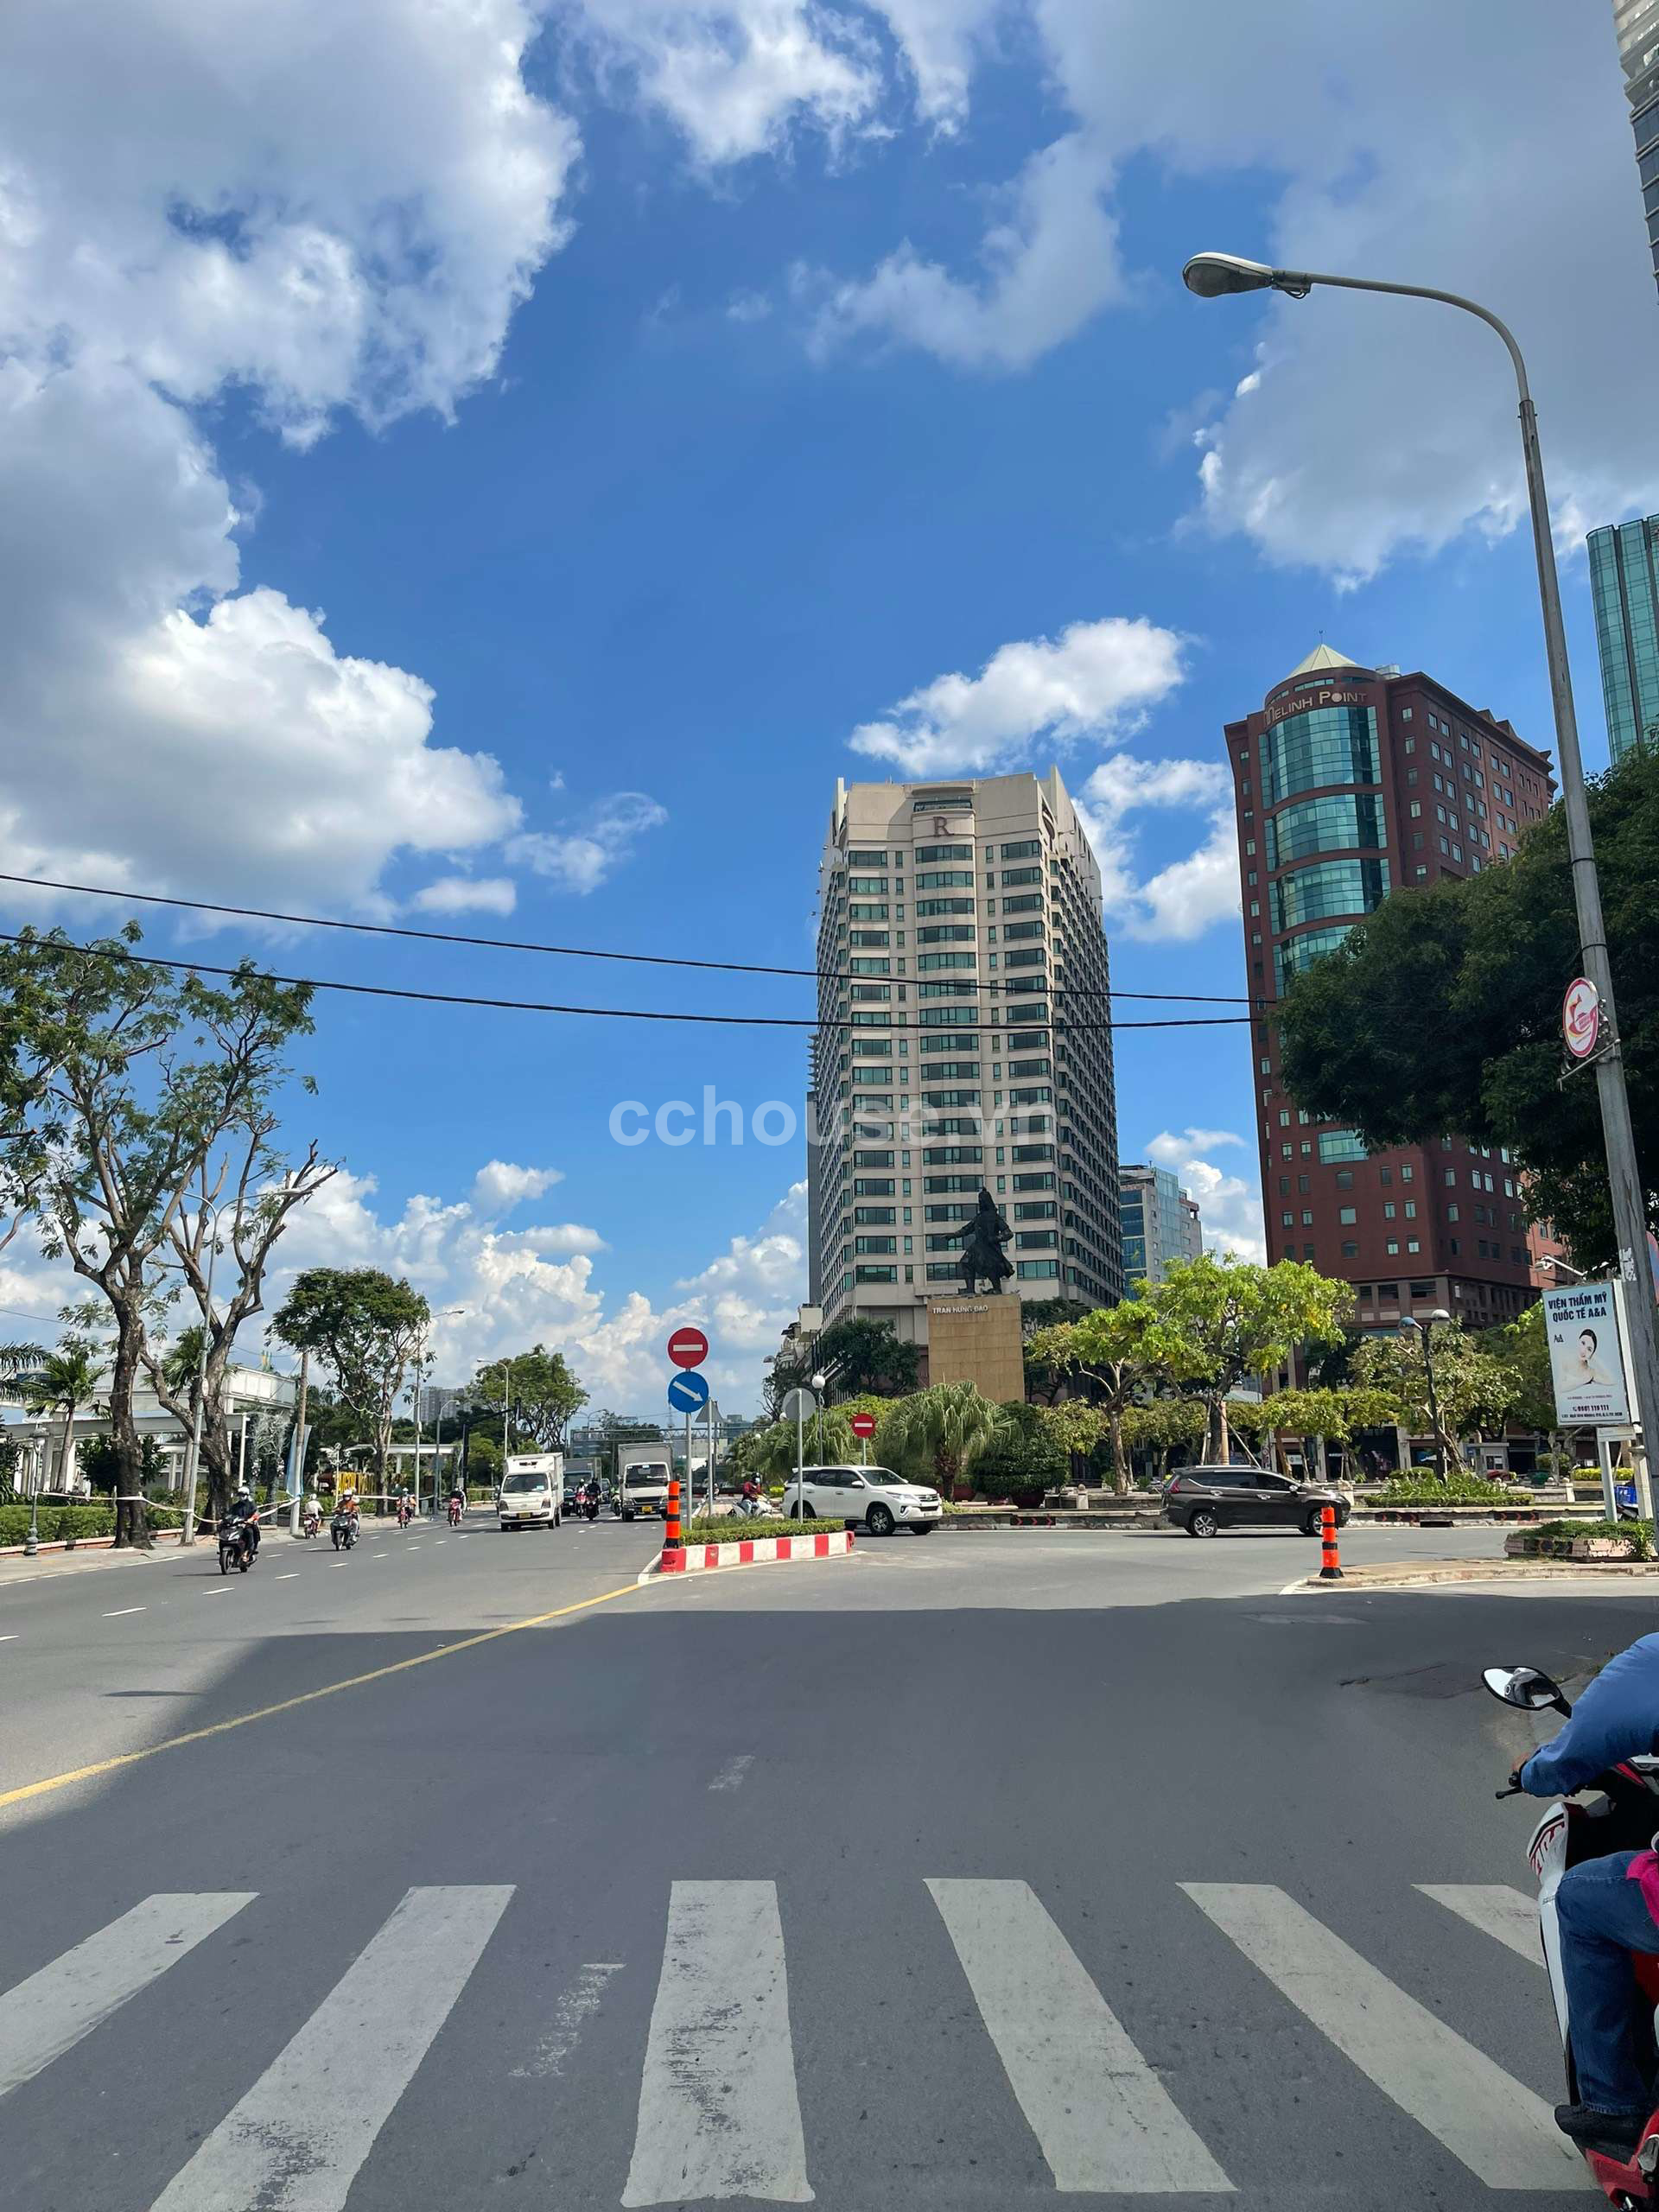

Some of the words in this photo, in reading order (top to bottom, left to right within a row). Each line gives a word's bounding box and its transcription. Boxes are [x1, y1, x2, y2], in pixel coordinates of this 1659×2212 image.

[1319, 691, 1367, 705] POINT
[933, 816, 952, 837] R
[1548, 1298, 1567, 1310] VIỆN
[1553, 1308, 1574, 1323] QUỐC
[1576, 1306, 1586, 1319] TẾ
[1588, 1306, 1607, 1318] A&A
